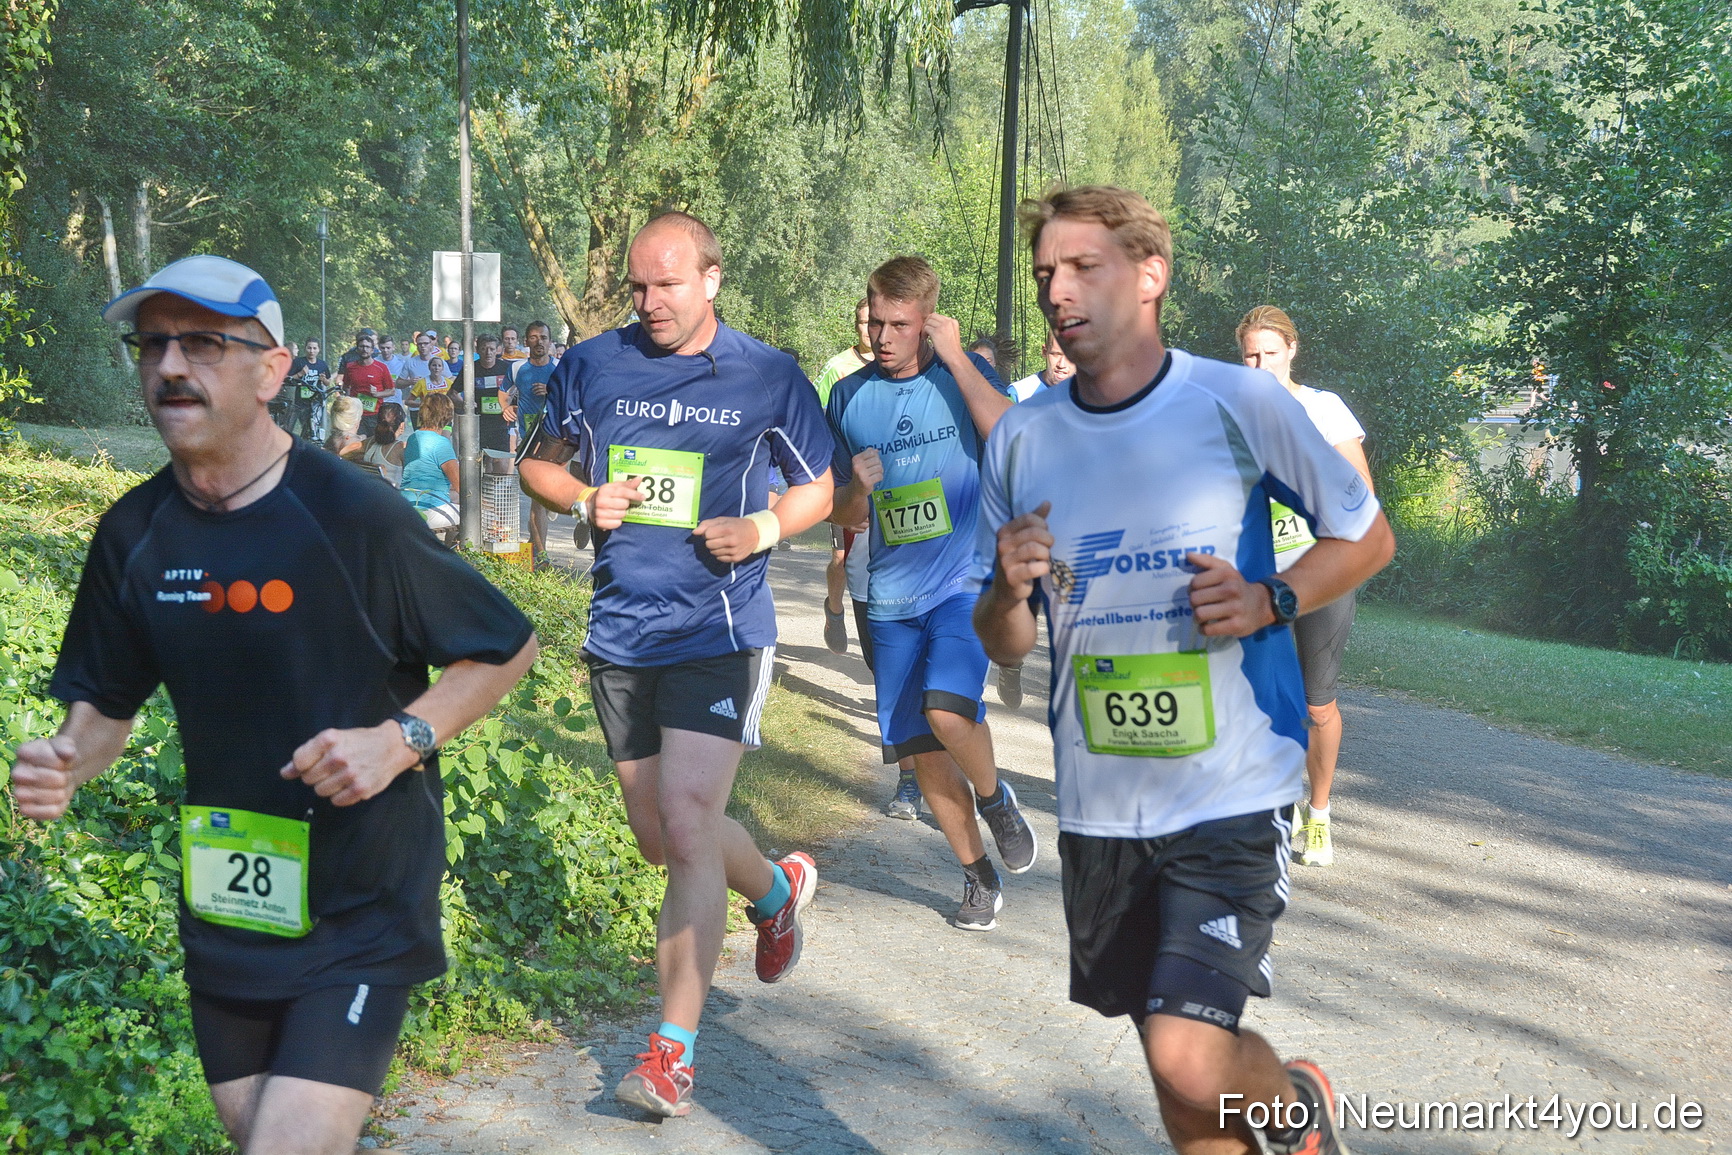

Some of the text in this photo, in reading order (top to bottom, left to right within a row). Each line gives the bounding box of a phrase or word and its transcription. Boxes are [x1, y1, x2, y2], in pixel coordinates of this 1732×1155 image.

[615, 399, 742, 427] EURO POLES
[895, 453, 921, 467] TEAM
[885, 500, 937, 529] 1770
[164, 568, 204, 581] APTIV
[186, 590, 212, 602] Team
[1105, 691, 1178, 727] 639
[1112, 728, 1179, 741] Enigk Sascha
[227, 852, 272, 898] 28
[211, 892, 260, 910] Steinmetz
